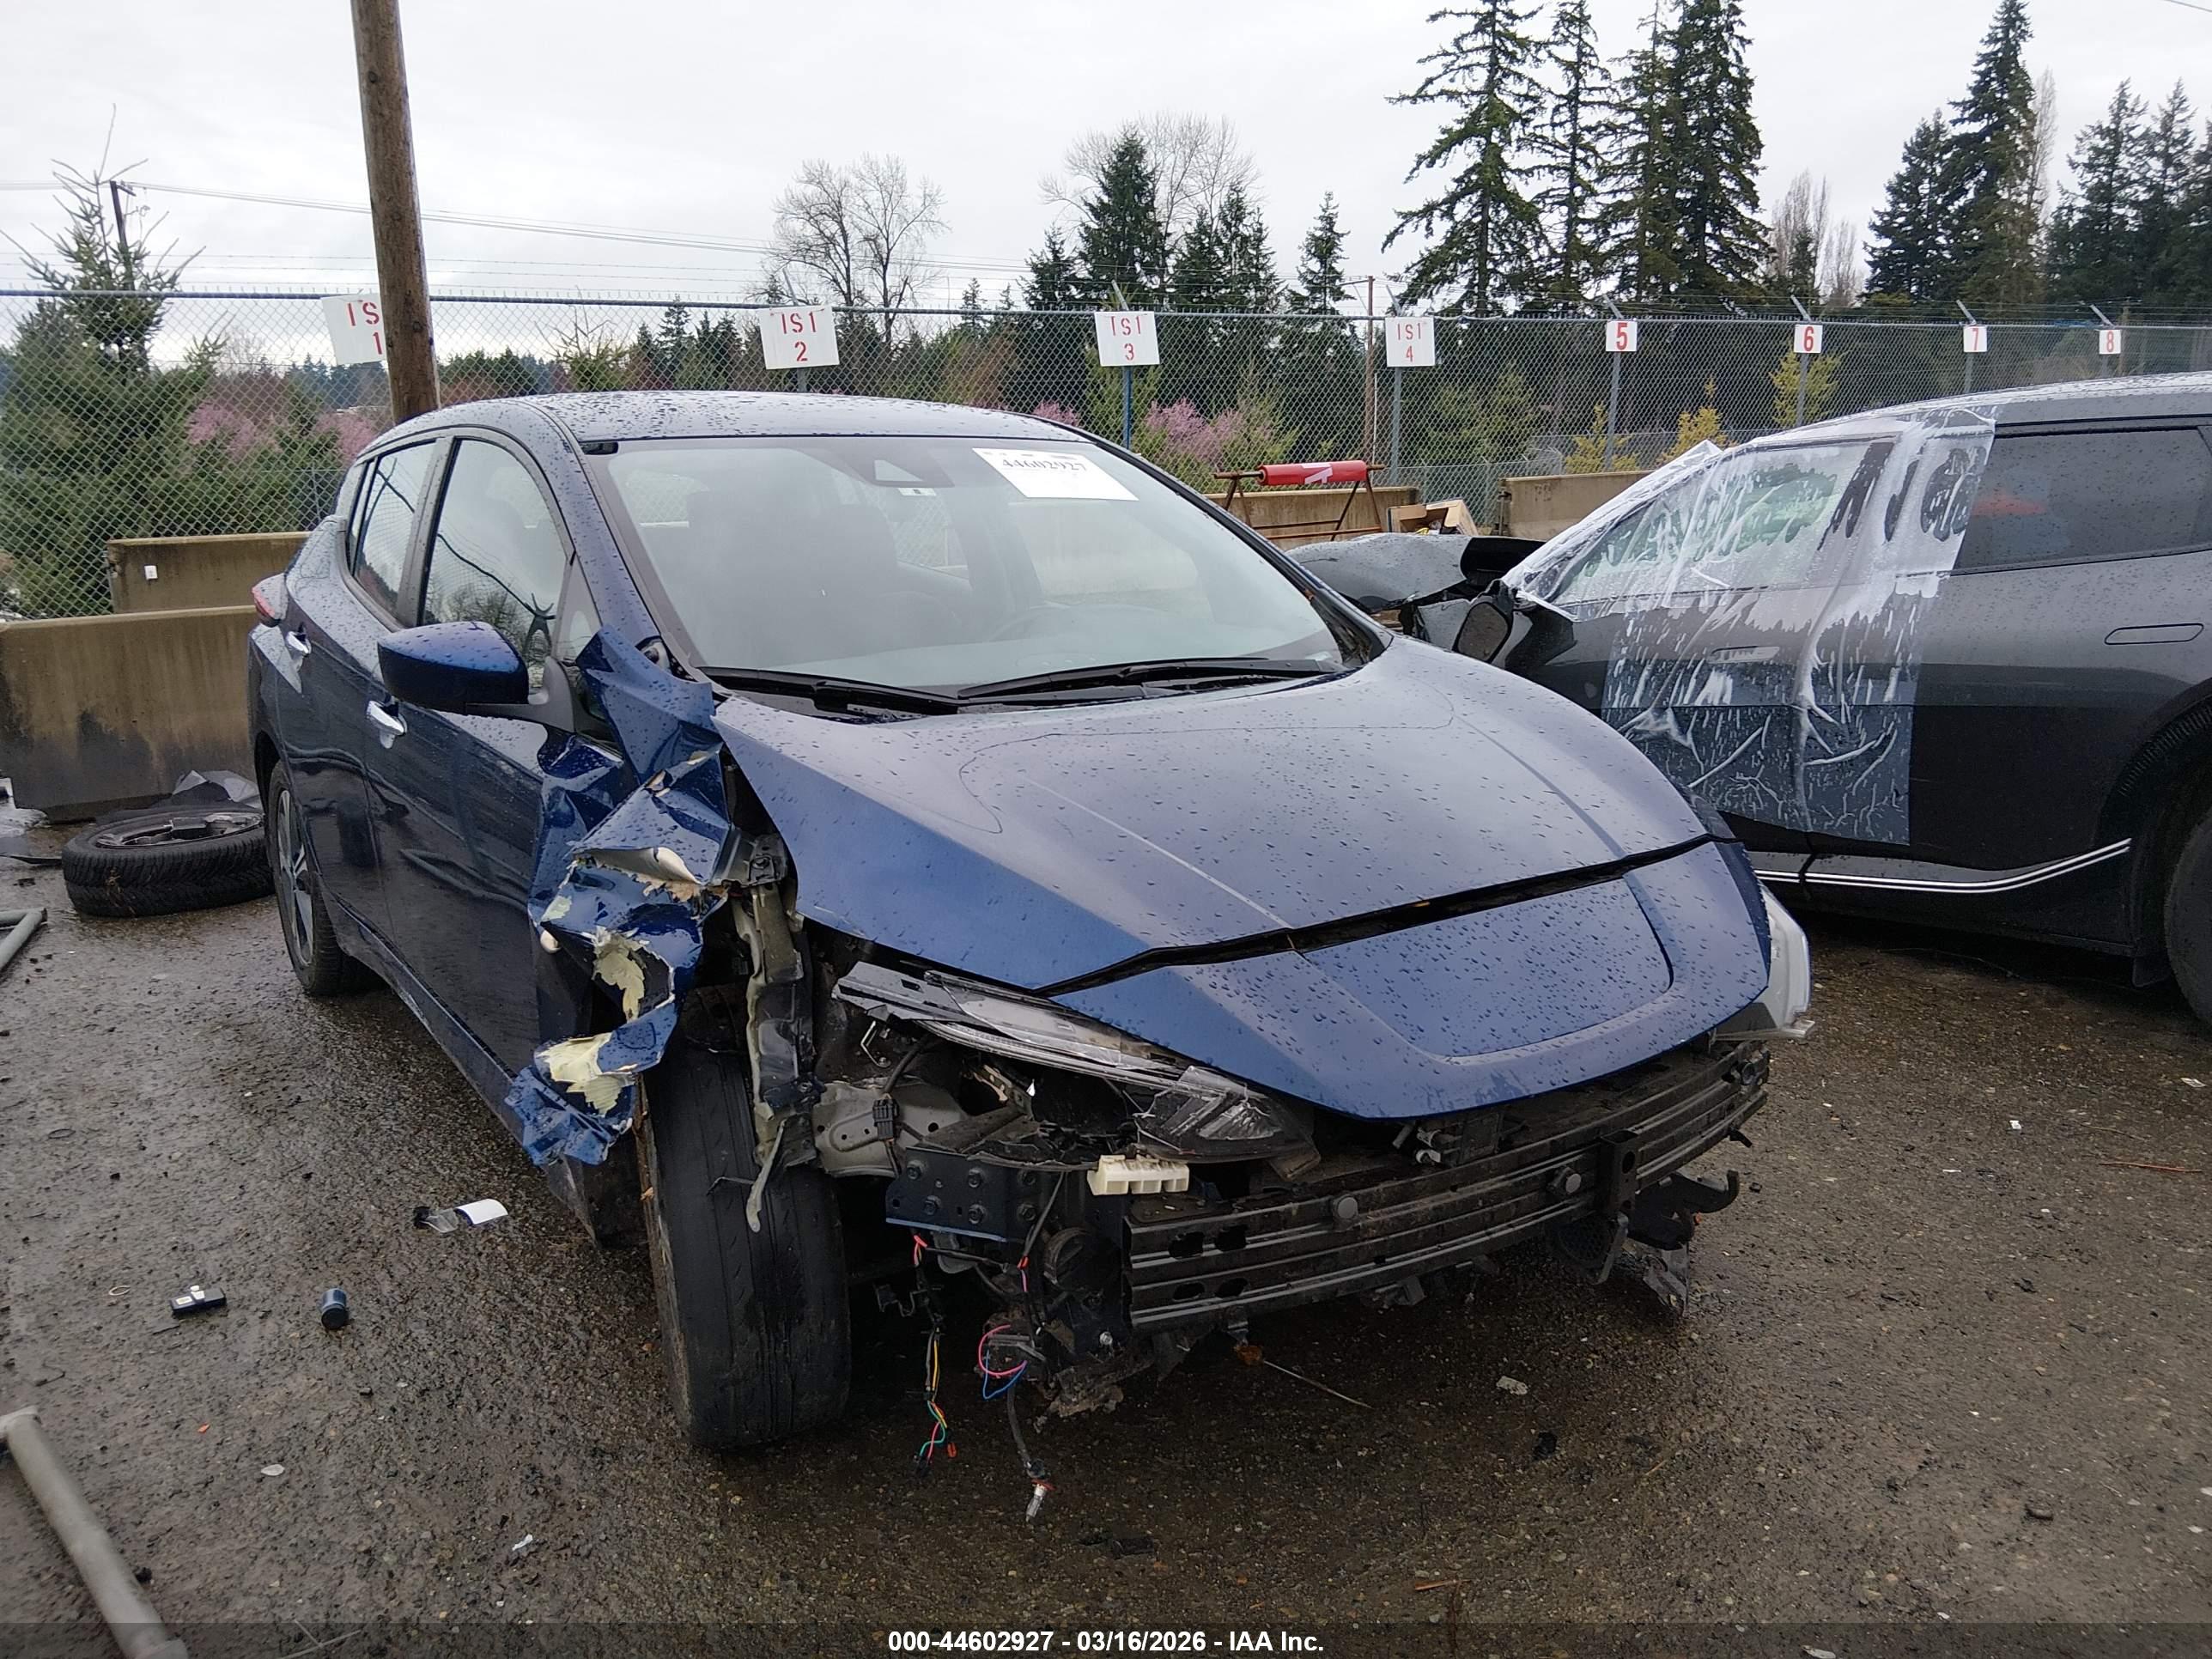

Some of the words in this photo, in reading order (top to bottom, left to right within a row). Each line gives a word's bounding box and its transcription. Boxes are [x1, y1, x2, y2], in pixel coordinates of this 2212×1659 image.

[348, 301, 380, 326] IS
[374, 332, 382, 355] 1
[1616, 322, 1627, 350] 5
[1804, 326, 1814, 351] 6
[1972, 327, 1979, 351] 7
[2106, 331, 2114, 352] 8
[795, 342, 808, 362] 2
[1124, 343, 1134, 361] 3
[1406, 345, 1413, 362] 4
